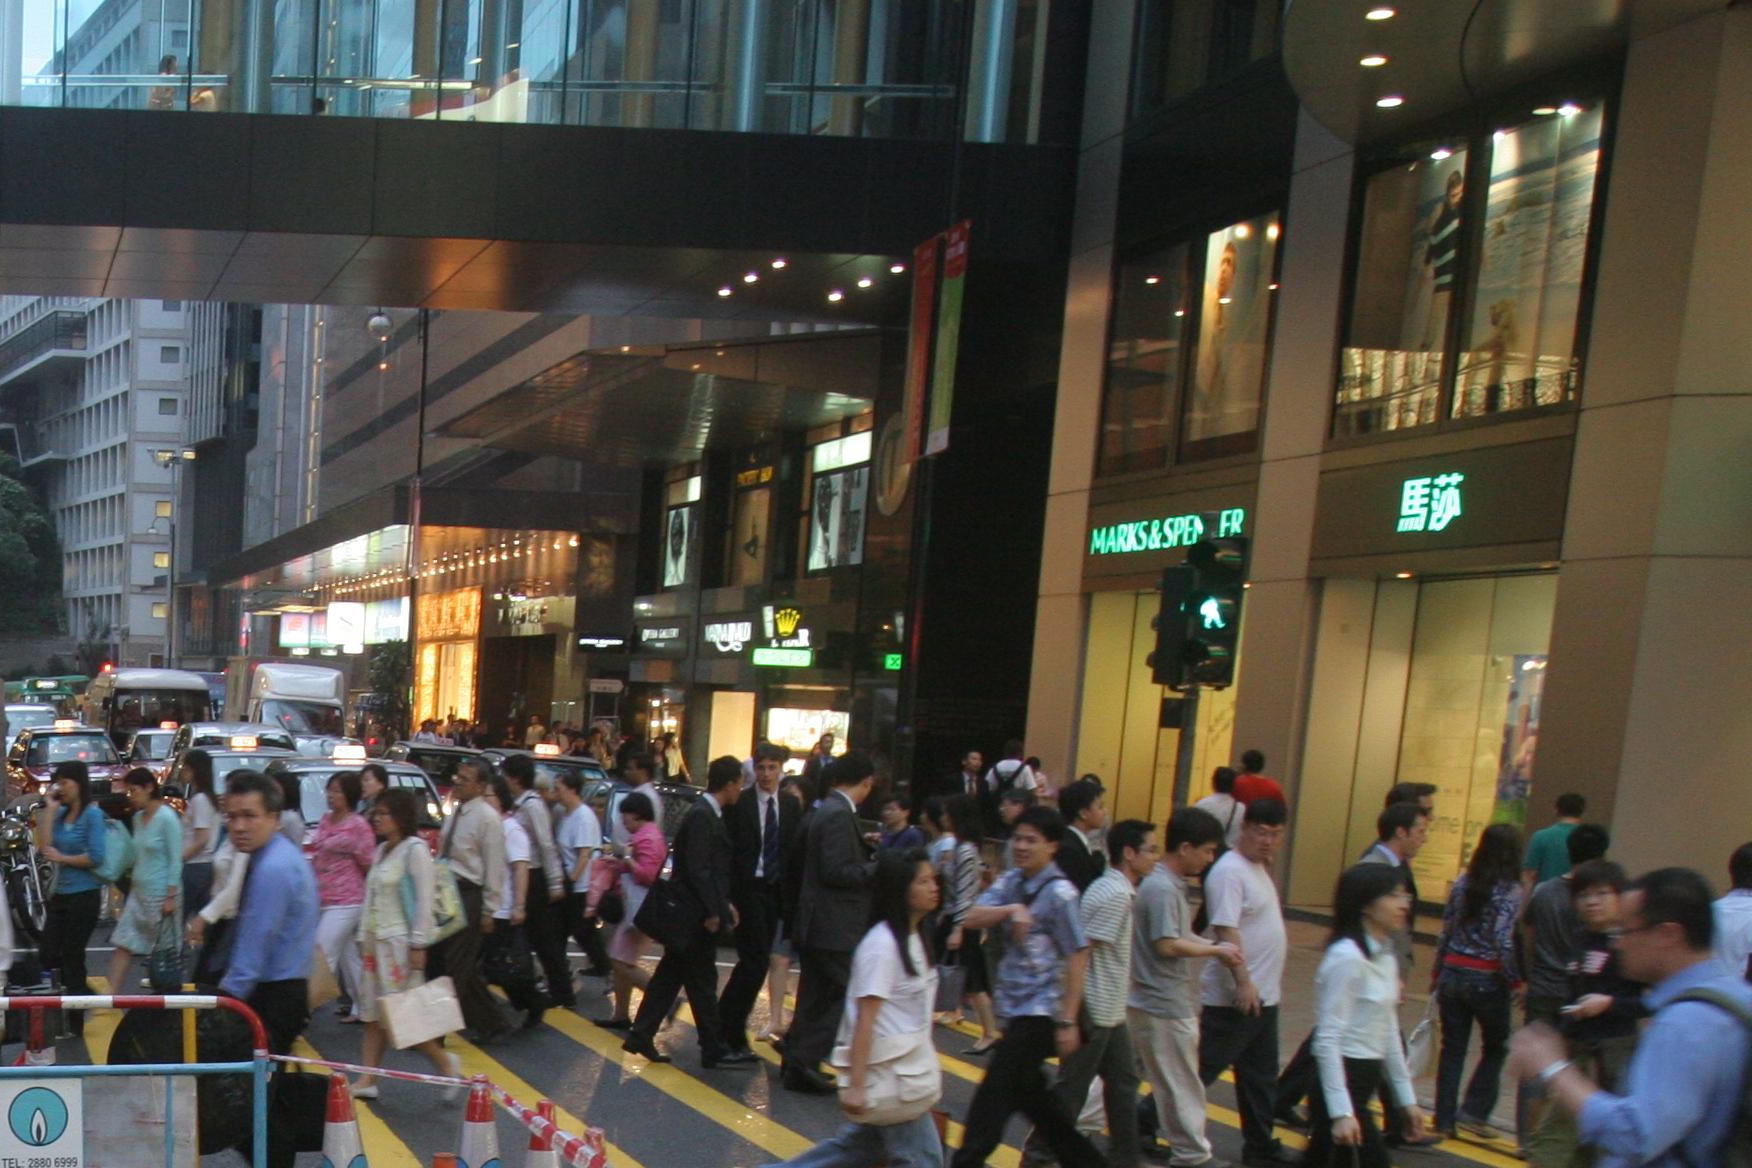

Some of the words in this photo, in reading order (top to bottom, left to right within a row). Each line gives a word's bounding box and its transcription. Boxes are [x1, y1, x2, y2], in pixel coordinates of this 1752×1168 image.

[1397, 473, 1464, 532] 馬莎
[1, 1157, 25, 1168] TEL:
[28, 1157, 52, 1168] 2880
[54, 1156, 78, 1168] 6999
